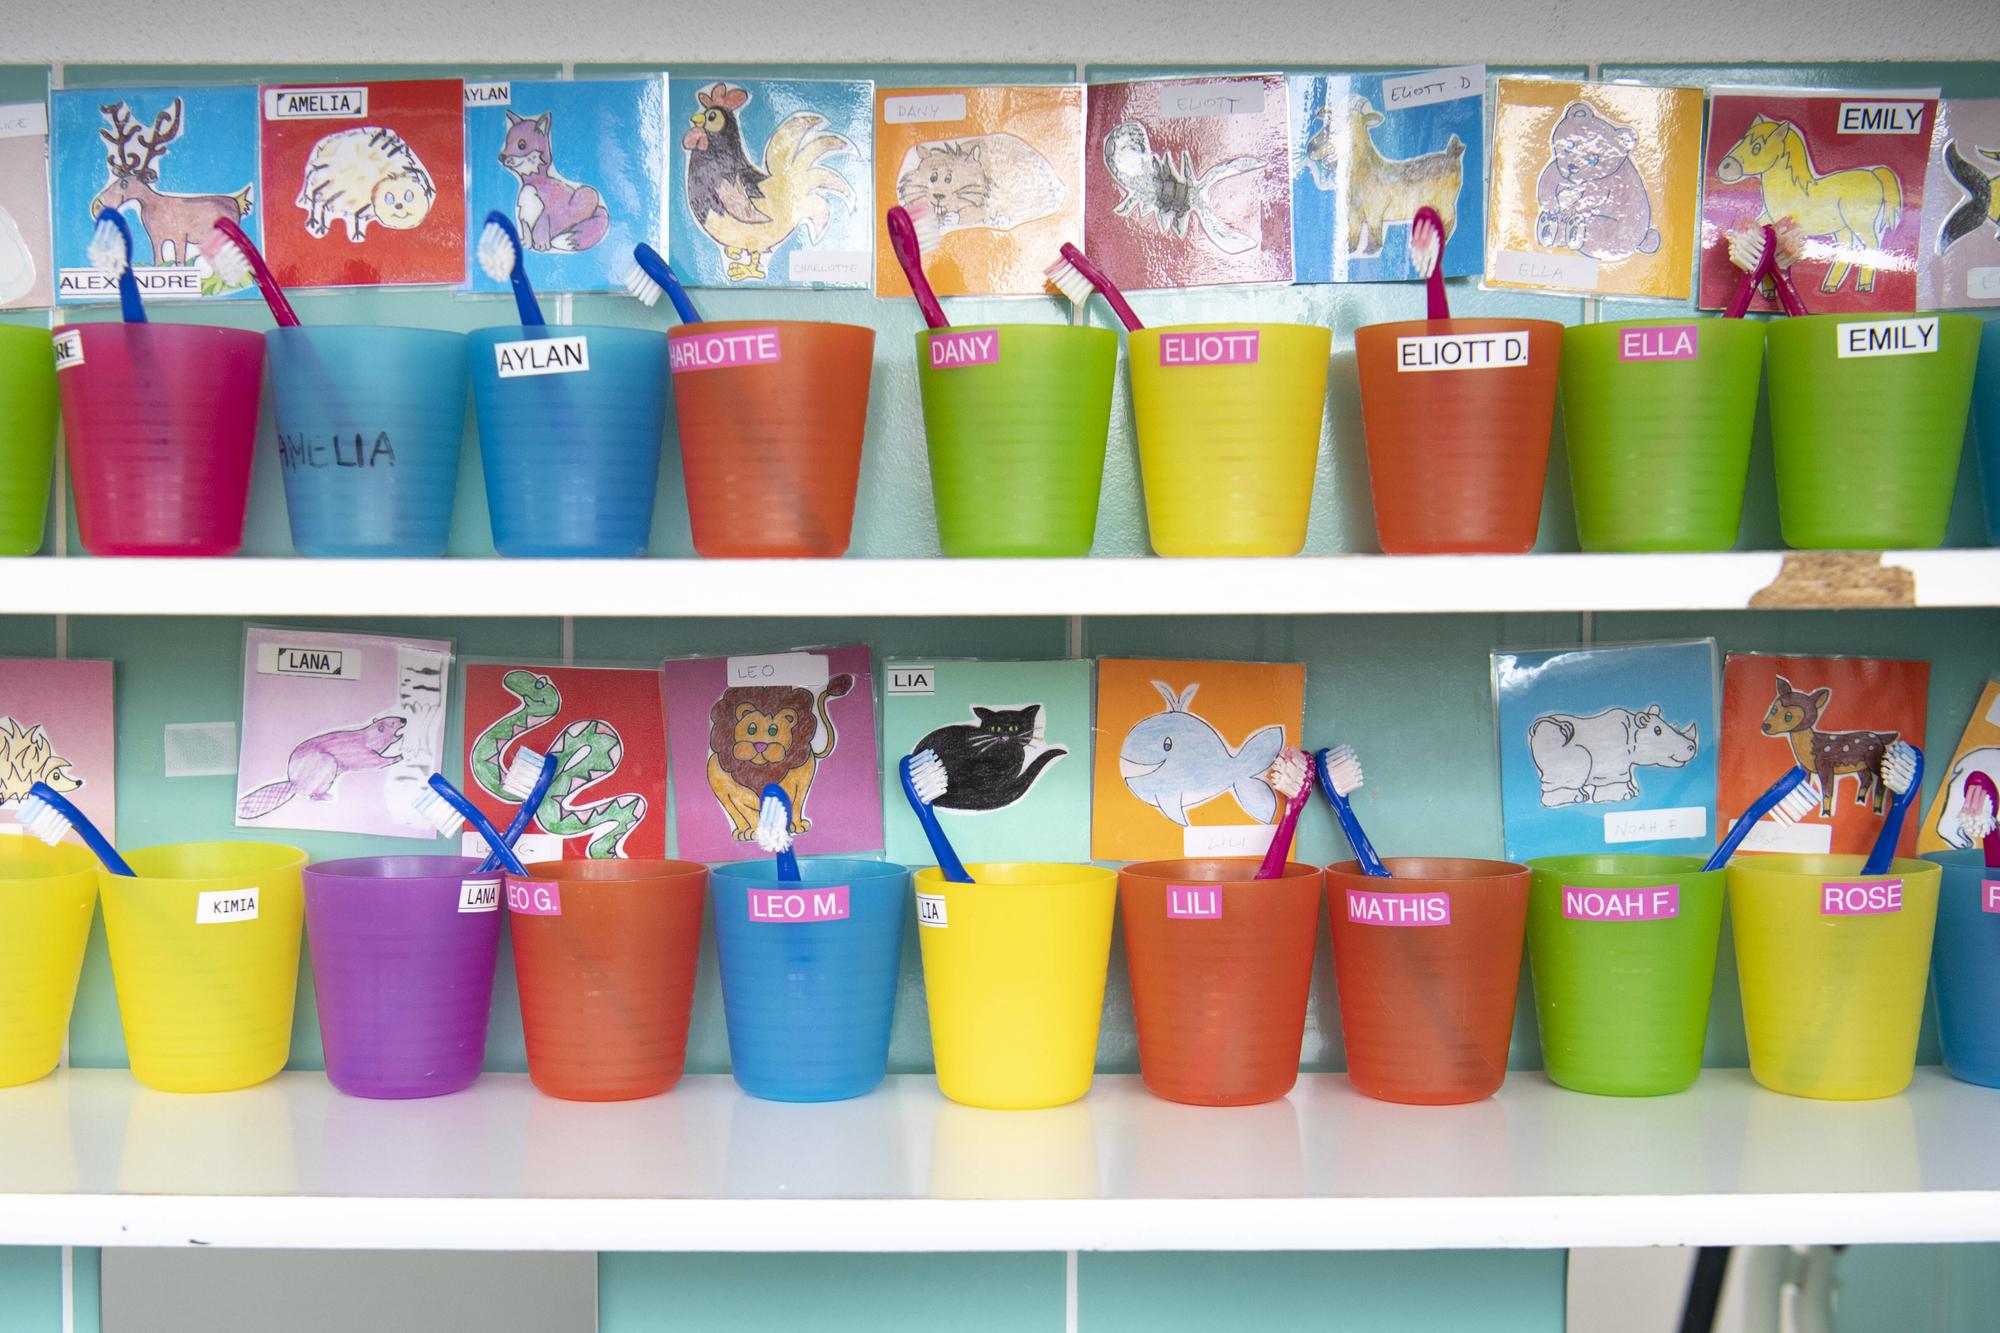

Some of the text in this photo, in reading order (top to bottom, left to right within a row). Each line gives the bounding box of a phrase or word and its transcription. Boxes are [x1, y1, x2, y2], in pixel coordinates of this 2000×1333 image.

[289, 96, 350, 112] AMELIA
[897, 105, 940, 118] DANY
[1843, 108, 1923, 130] EMILY
[60, 275, 198, 289] ALEXNDRE
[1519, 262, 1563, 279] ELLA
[1165, 335, 1257, 362] ELIOTT
[1624, 331, 1693, 357] ELLA
[1850, 323, 1934, 352] EMILY
[500, 342, 582, 371] AYLAN
[932, 335, 993, 364] DANY
[1402, 339, 1527, 365] ELIOTT D.
[290, 652, 330, 670] LANA
[738, 665, 774, 679] LEO
[894, 674, 928, 687] LIA
[213, 897, 255, 913] KIMIA
[467, 888, 495, 905] LANA
[534, 888, 558, 911] G.
[753, 893, 843, 918] LEO M.
[1173, 891, 1216, 914] LILI
[1567, 891, 1675, 917] NOAH F.
[1825, 885, 1902, 911] ROSE
[921, 901, 939, 919] LIA
[1349, 896, 1446, 922] MATHIS
